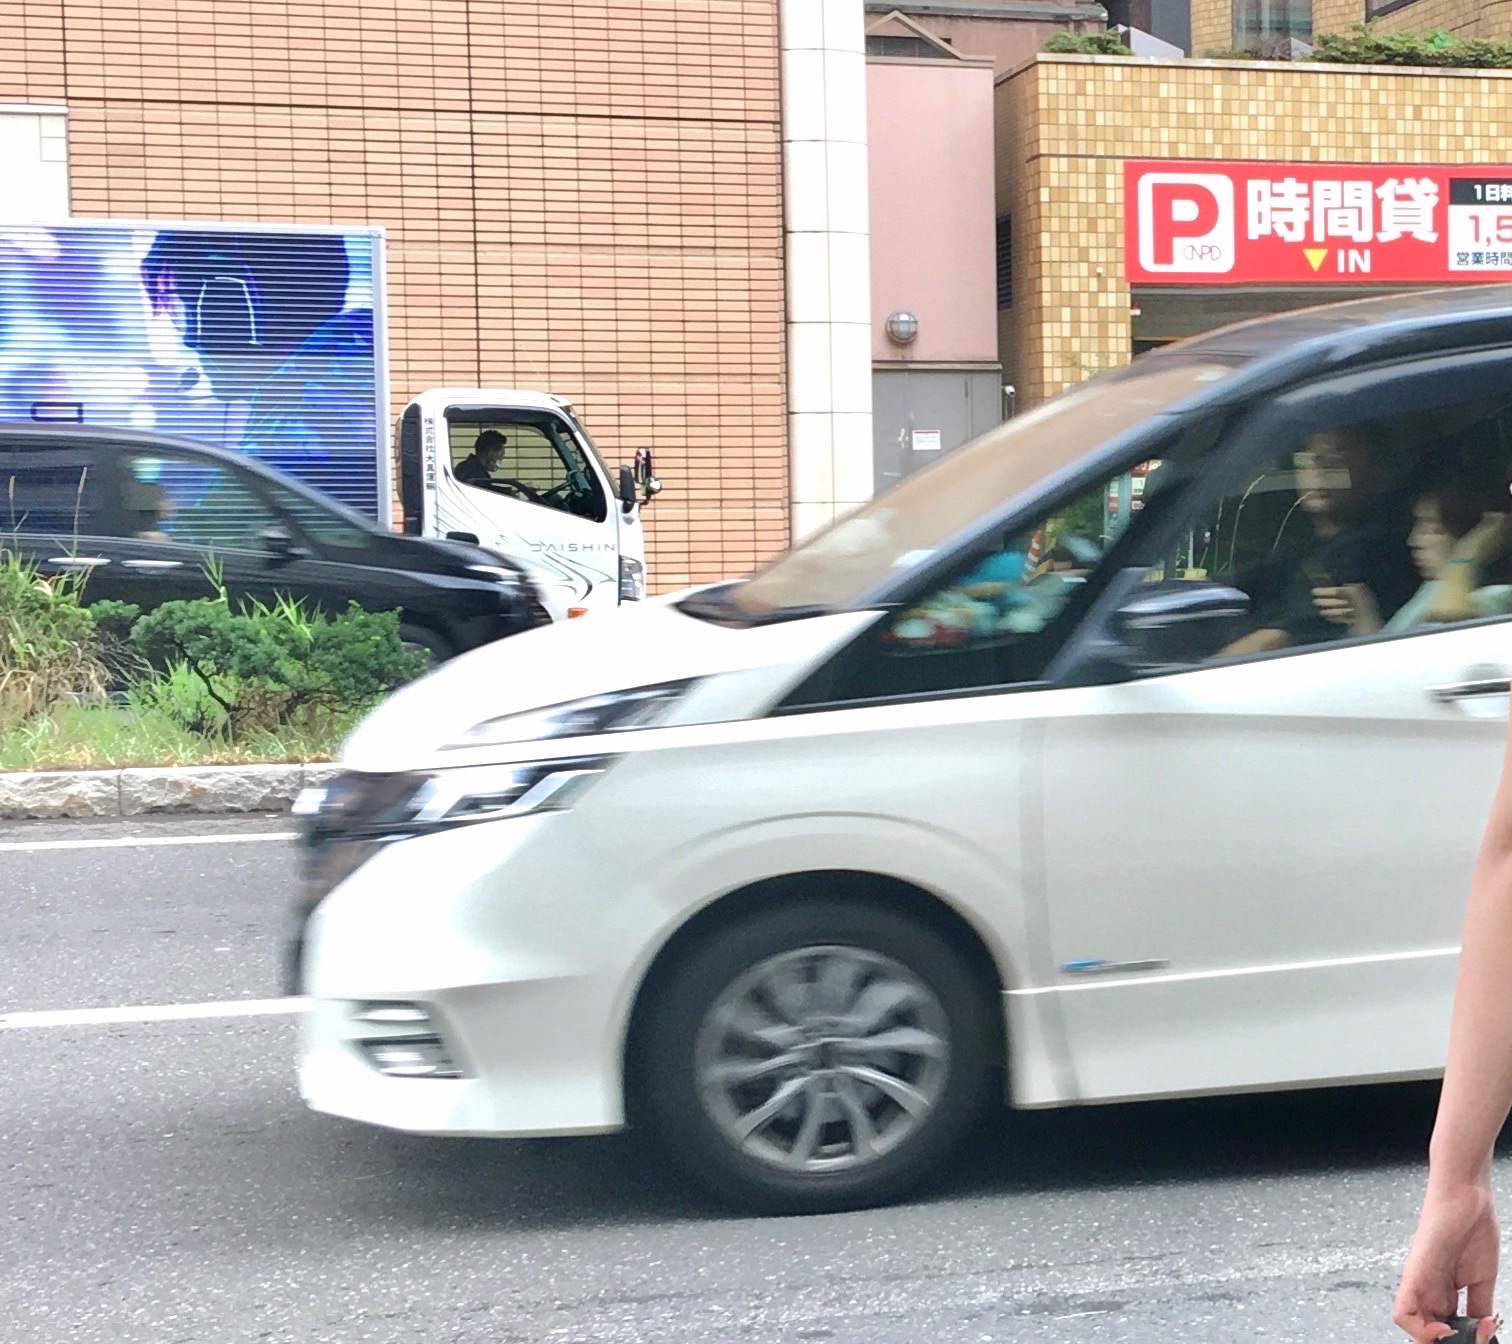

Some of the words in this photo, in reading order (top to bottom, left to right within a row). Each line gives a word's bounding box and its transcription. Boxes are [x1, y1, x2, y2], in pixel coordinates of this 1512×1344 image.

[1152, 182, 1219, 265] P
[1247, 177, 1439, 243] 時間貸
[1337, 249, 1371, 273] IN
[530, 543, 616, 552] DAISHIN
